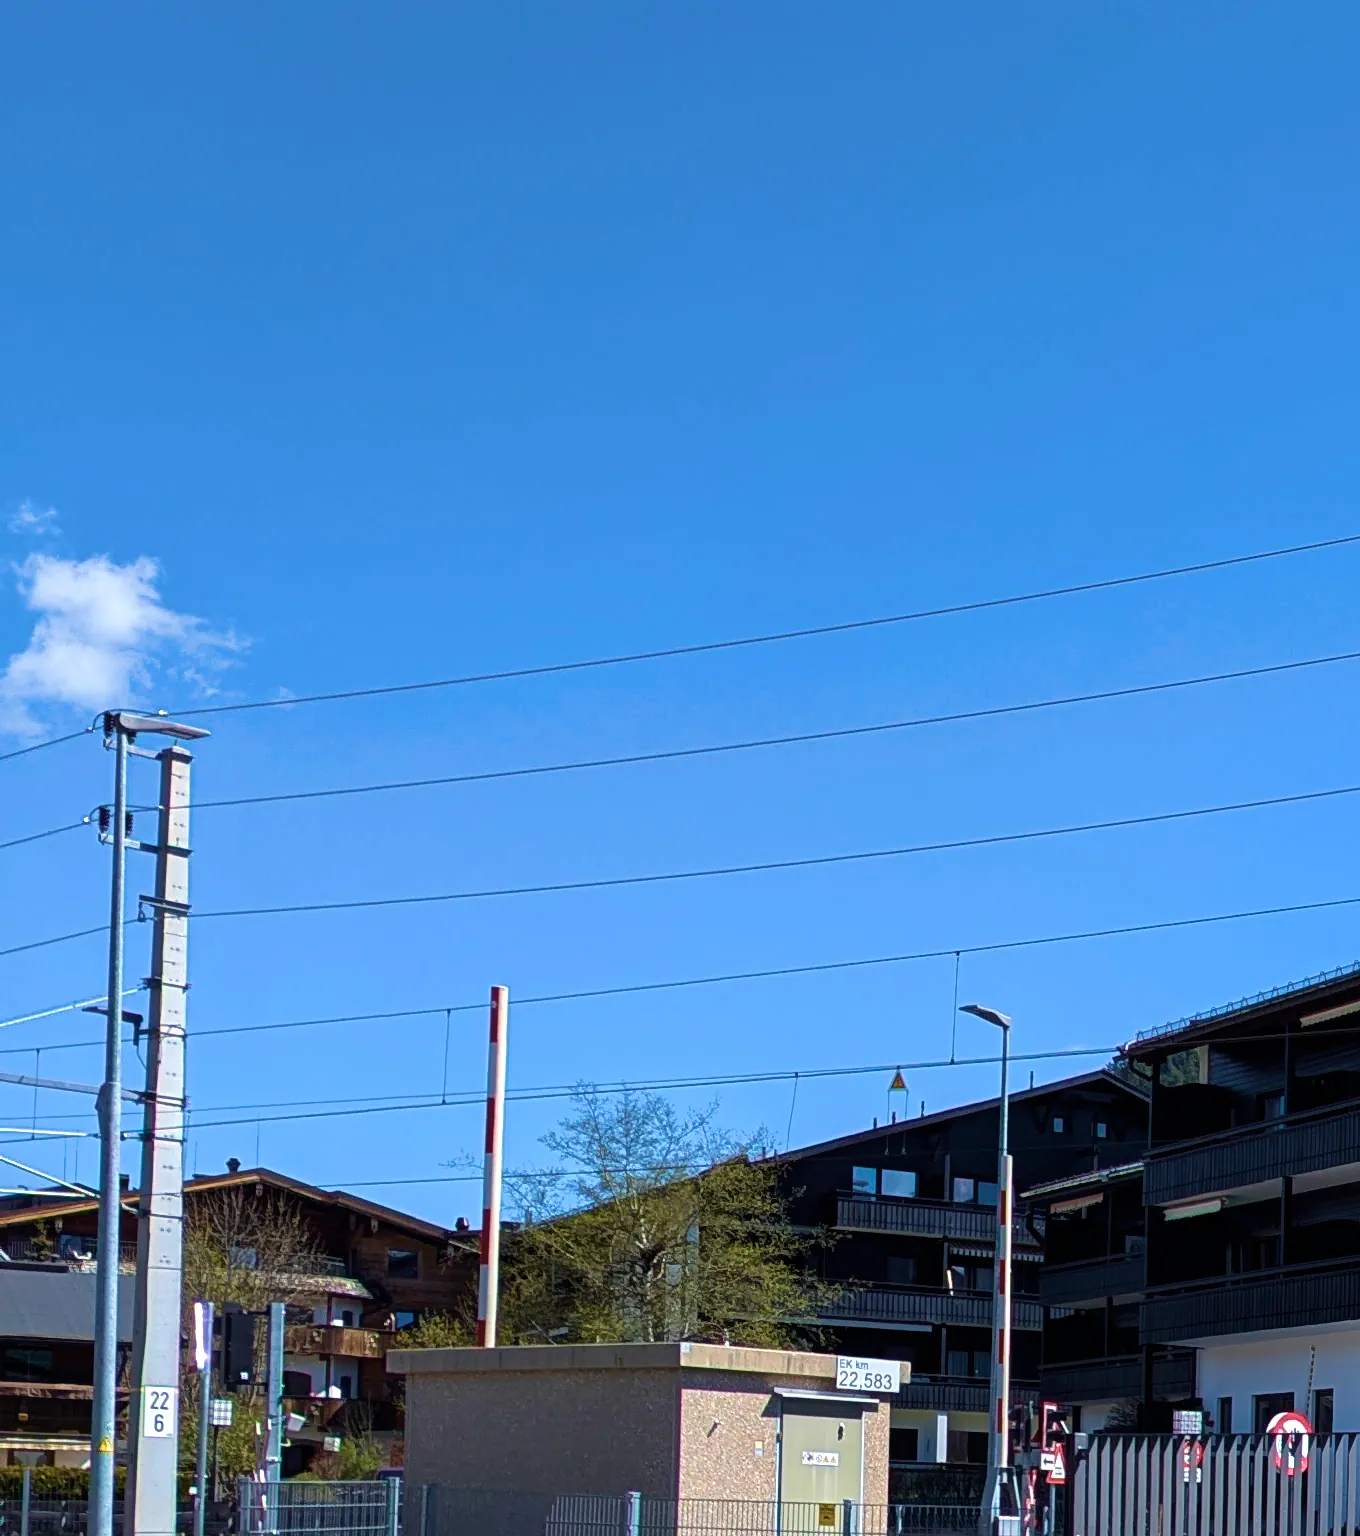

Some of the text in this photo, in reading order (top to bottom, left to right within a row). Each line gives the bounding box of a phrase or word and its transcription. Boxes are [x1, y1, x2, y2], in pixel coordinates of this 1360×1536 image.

[840, 1358, 869, 1370] EK km
[150, 1391, 169, 1410] 22
[154, 1414, 164, 1432] 6
